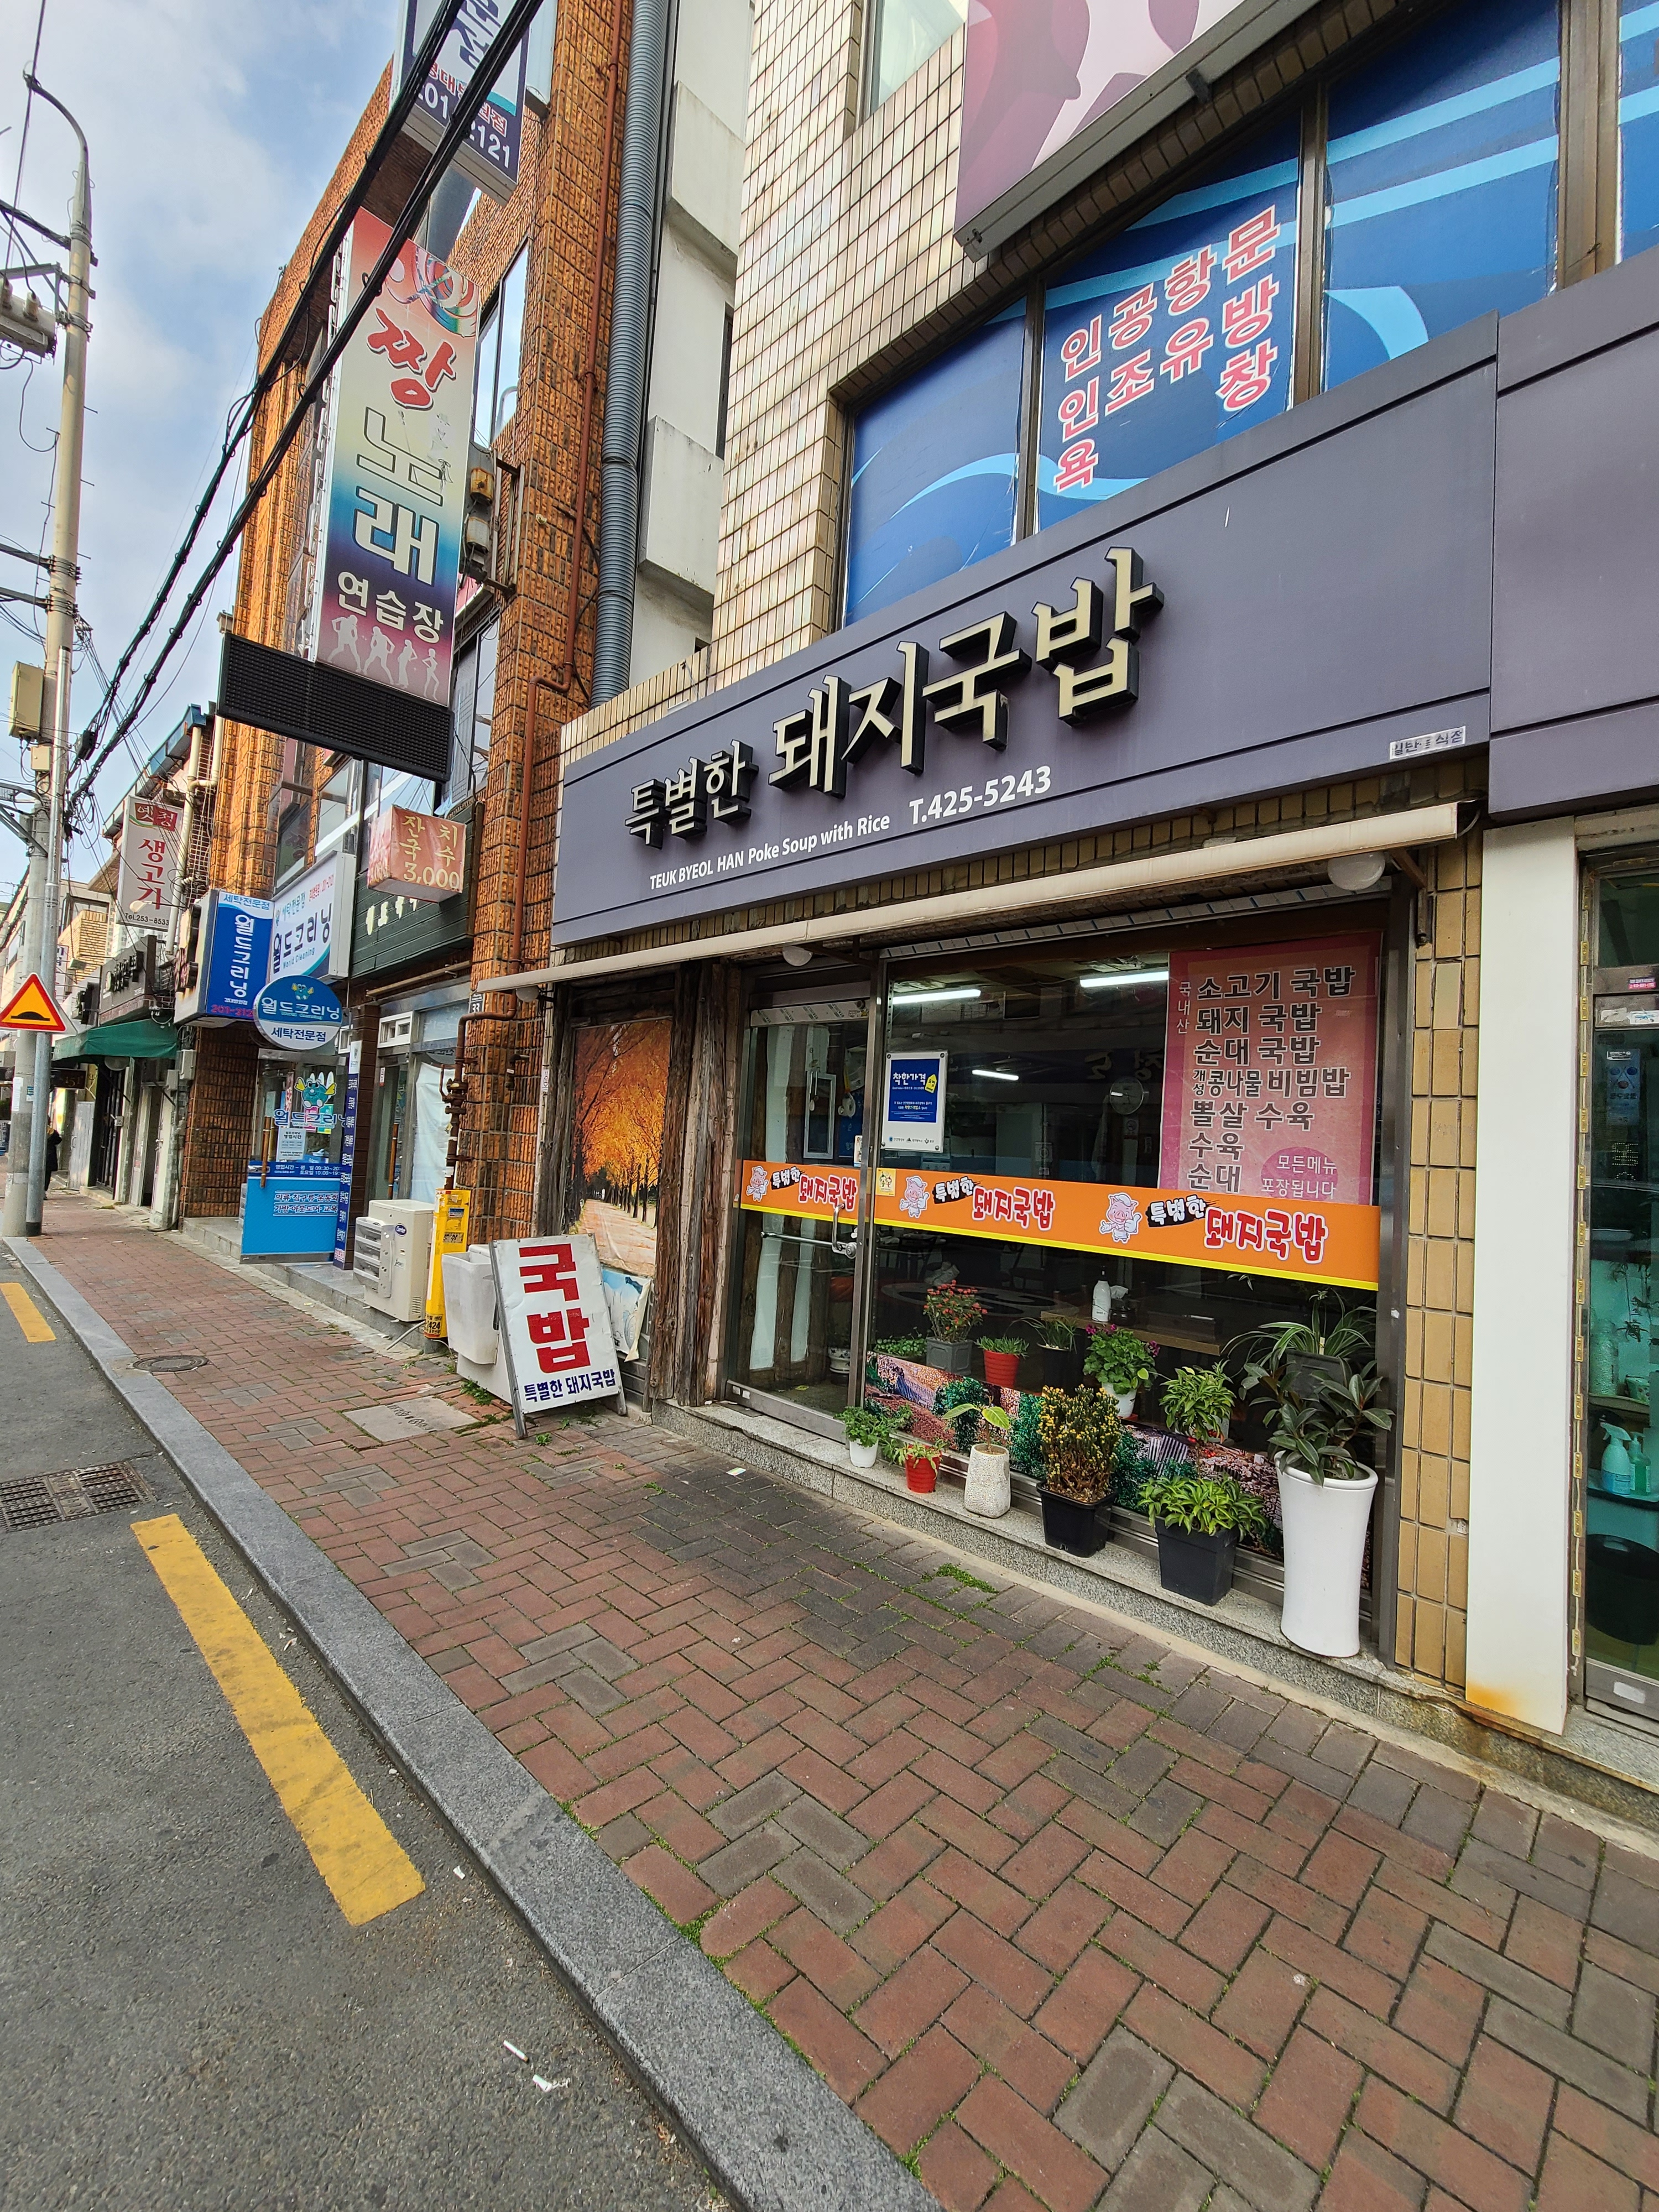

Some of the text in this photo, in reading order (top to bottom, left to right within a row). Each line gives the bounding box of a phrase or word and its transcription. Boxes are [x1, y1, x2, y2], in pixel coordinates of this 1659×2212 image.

[1061, 205, 1280, 382] 인공항문
[1057, 273, 1280, 442] 인조유방
[354, 406, 443, 586] 노래
[337, 571, 443, 644] 연습장
[769, 546, 1164, 798] 돼지국밥
[625, 739, 755, 848] 특별한
[909, 765, 1051, 826] T.425-5243
[650, 814, 890, 890] TEUK BYEOL HAN Poke Soup with Rice
[137, 838, 165, 910] 생고기
[403, 862, 460, 889] 3,000
[223, 894, 270, 911] 세탁전문점
[282, 891, 306, 921] 세탁전문점
[273, 902, 332, 974] 월드크리닝
[228, 914, 255, 998] 월드크리닝
[1197, 965, 1355, 1001] 소고기 국밥
[262, 997, 340, 1020] 월드크리닝
[1176, 981, 1192, 1035] 국내산
[1195, 1001, 1323, 1035] 돼지 국밥
[271, 1027, 326, 1042] 세탁전문점
[1193, 1037, 1250, 1067] 순대
[1257, 1035, 1321, 1066] 국밥
[893, 1072, 926, 1086] 착한가격
[1206, 1069, 1263, 1098] 콩나물
[1267, 1066, 1352, 1099] 비빔밥
[1190, 1099, 1315, 1132] 뽈살 수육
[1187, 1131, 1245, 1161] 수육
[771, 1165, 802, 1187] 특별한
[1186, 1163, 1243, 1194] 순대
[1276, 1154, 1338, 1175] 모든메뉴
[798, 1175, 858, 1212] 돼지국밥
[935, 1176, 975, 1203] 특별한
[1260, 1177, 1337, 1201] 포장됩니다
[972, 1186, 1056, 1232] 돼지국밥
[1149, 1194, 1207, 1225] 특별한
[1204, 1206, 1329, 1265] 돼지국밥
[519, 1244, 591, 1374] 국밥
[524, 1368, 616, 1403] 특별한 돼지국밥
